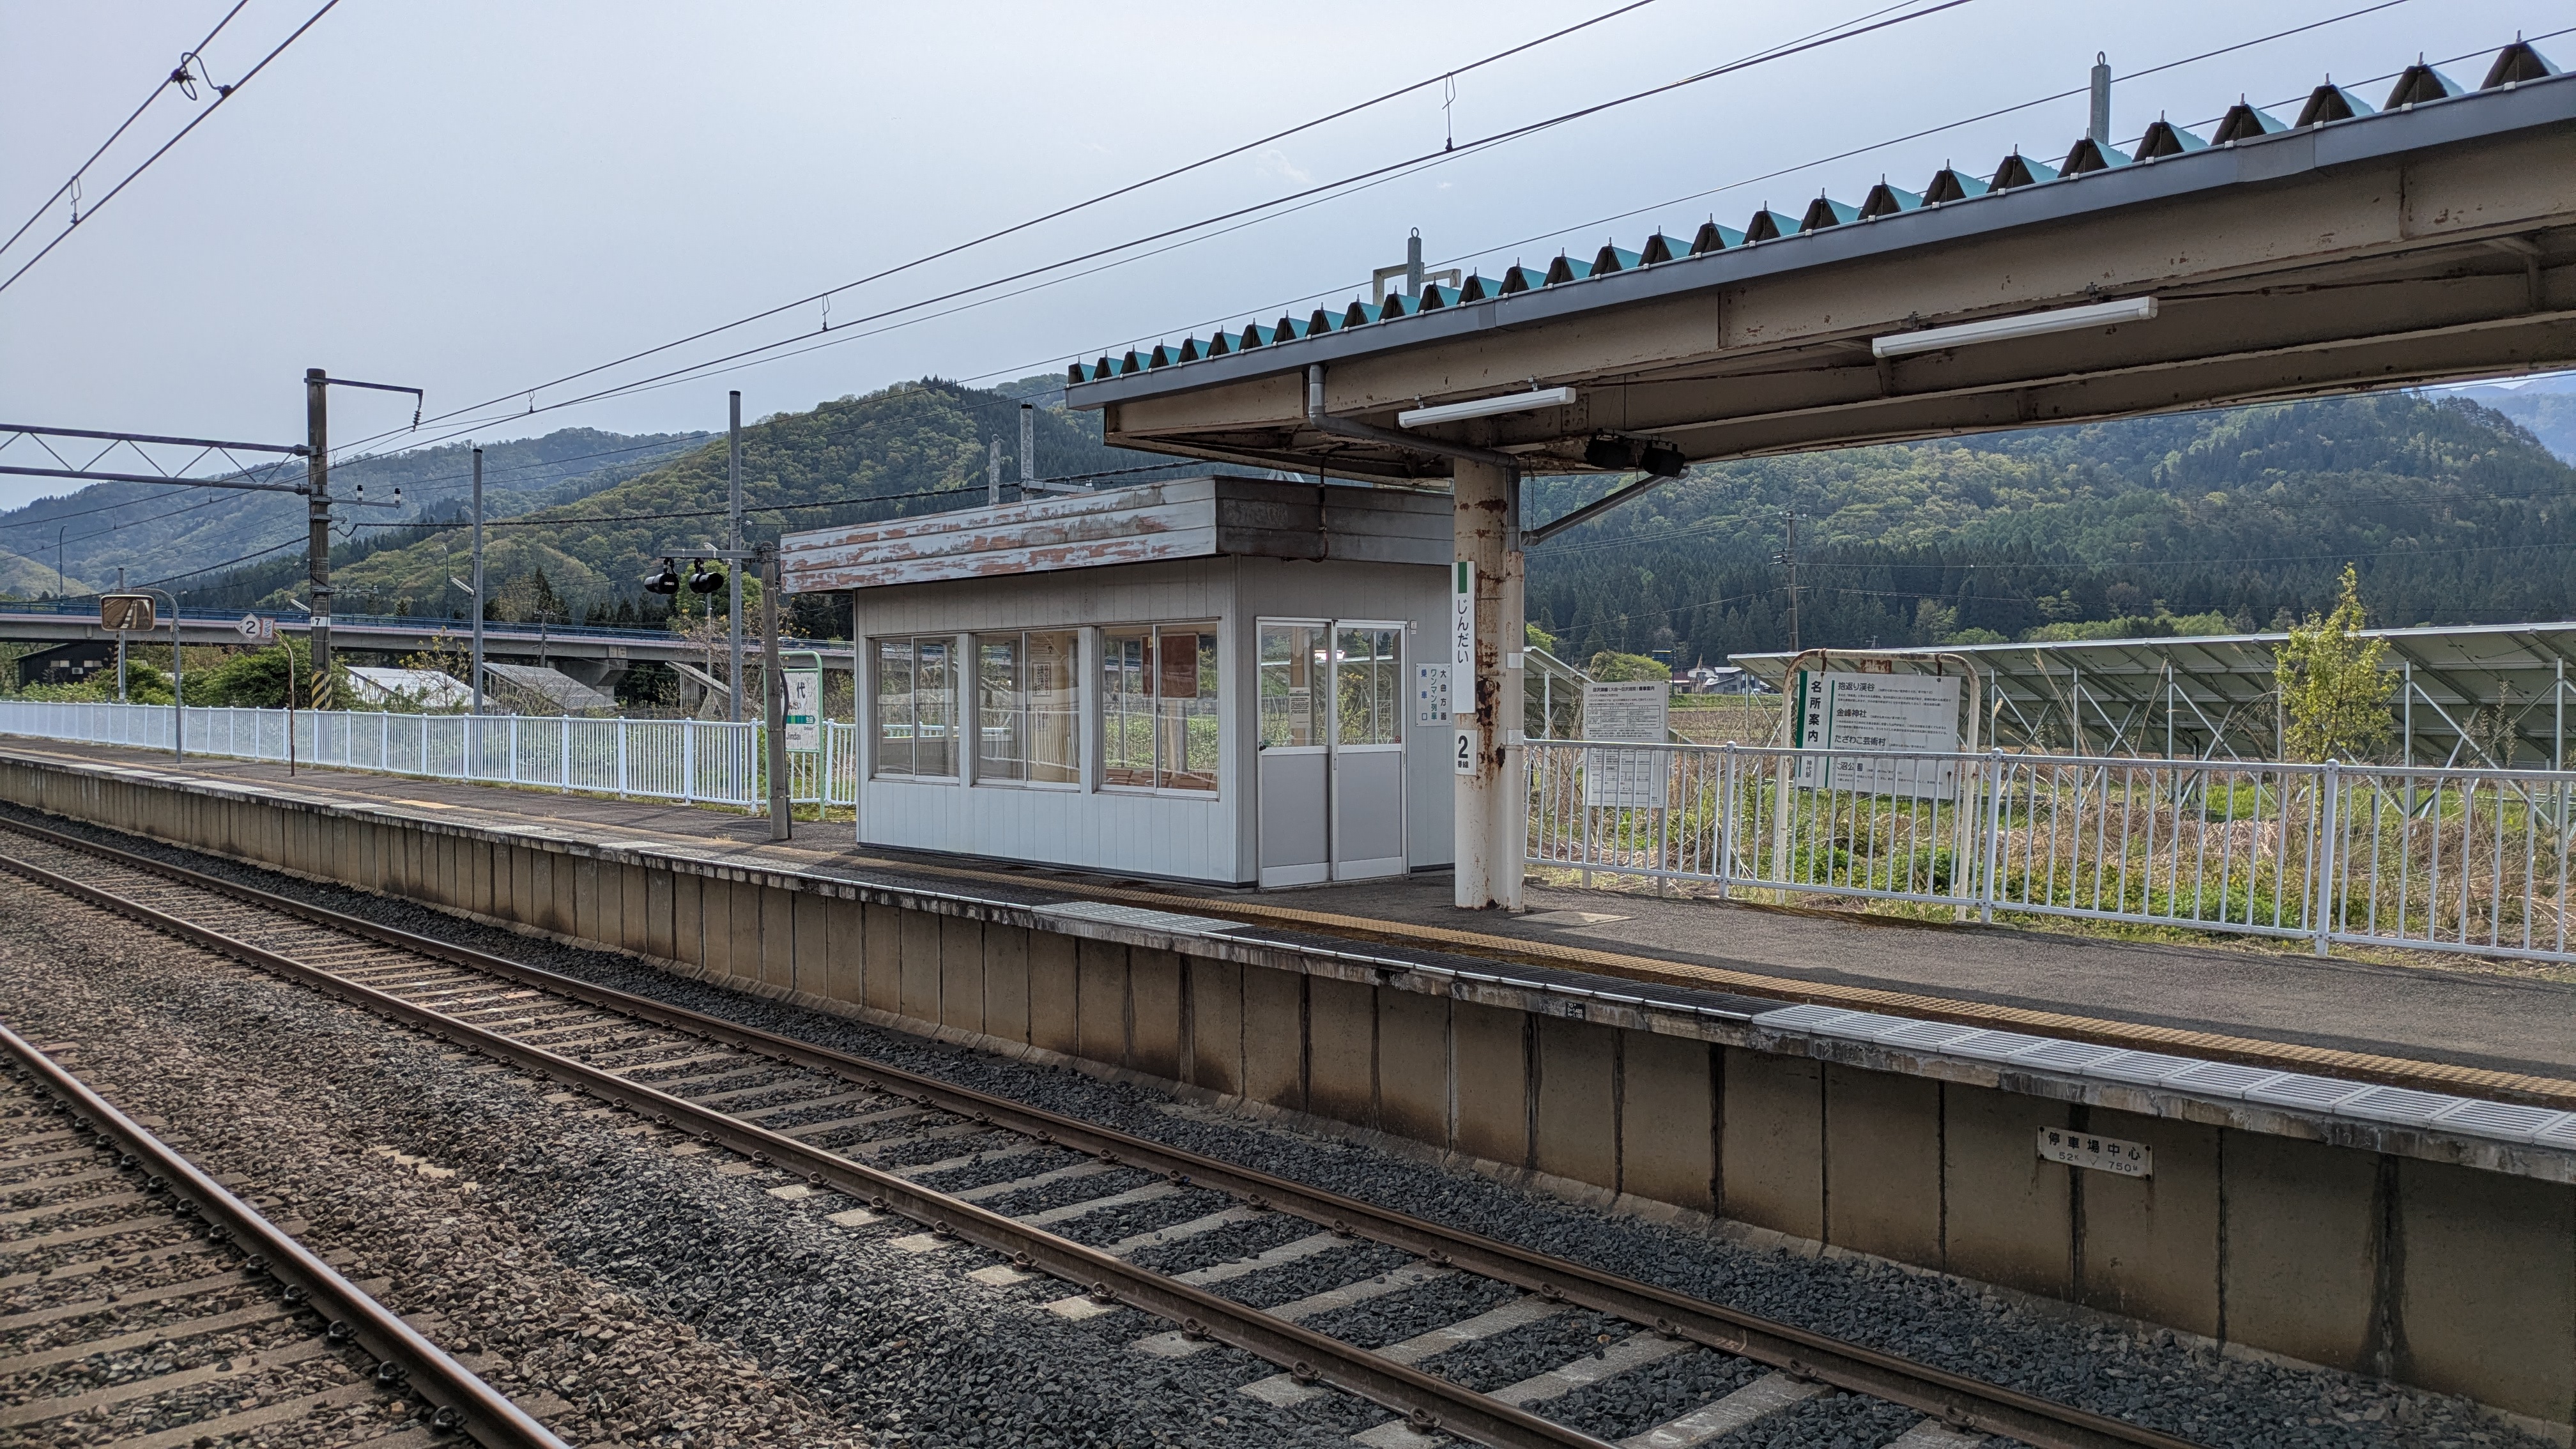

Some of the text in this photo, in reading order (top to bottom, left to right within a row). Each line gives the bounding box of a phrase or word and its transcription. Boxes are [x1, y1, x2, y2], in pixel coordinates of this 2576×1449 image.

[246, 620, 256, 634] 2
[1457, 599, 1469, 663] じんだい
[1837, 682, 1875, 692] 抱返り渓谷
[1807, 680, 1822, 742] 名所案内
[1836, 708, 1867, 718] 金峰神社
[786, 732, 801, 740] Jindai
[1834, 735, 1886, 746] たざわこ芸術村
[1458, 735, 1468, 758] 2
[1457, 760, 1469, 769] 番線
[2048, 1131, 2141, 1161] 停車場中心
